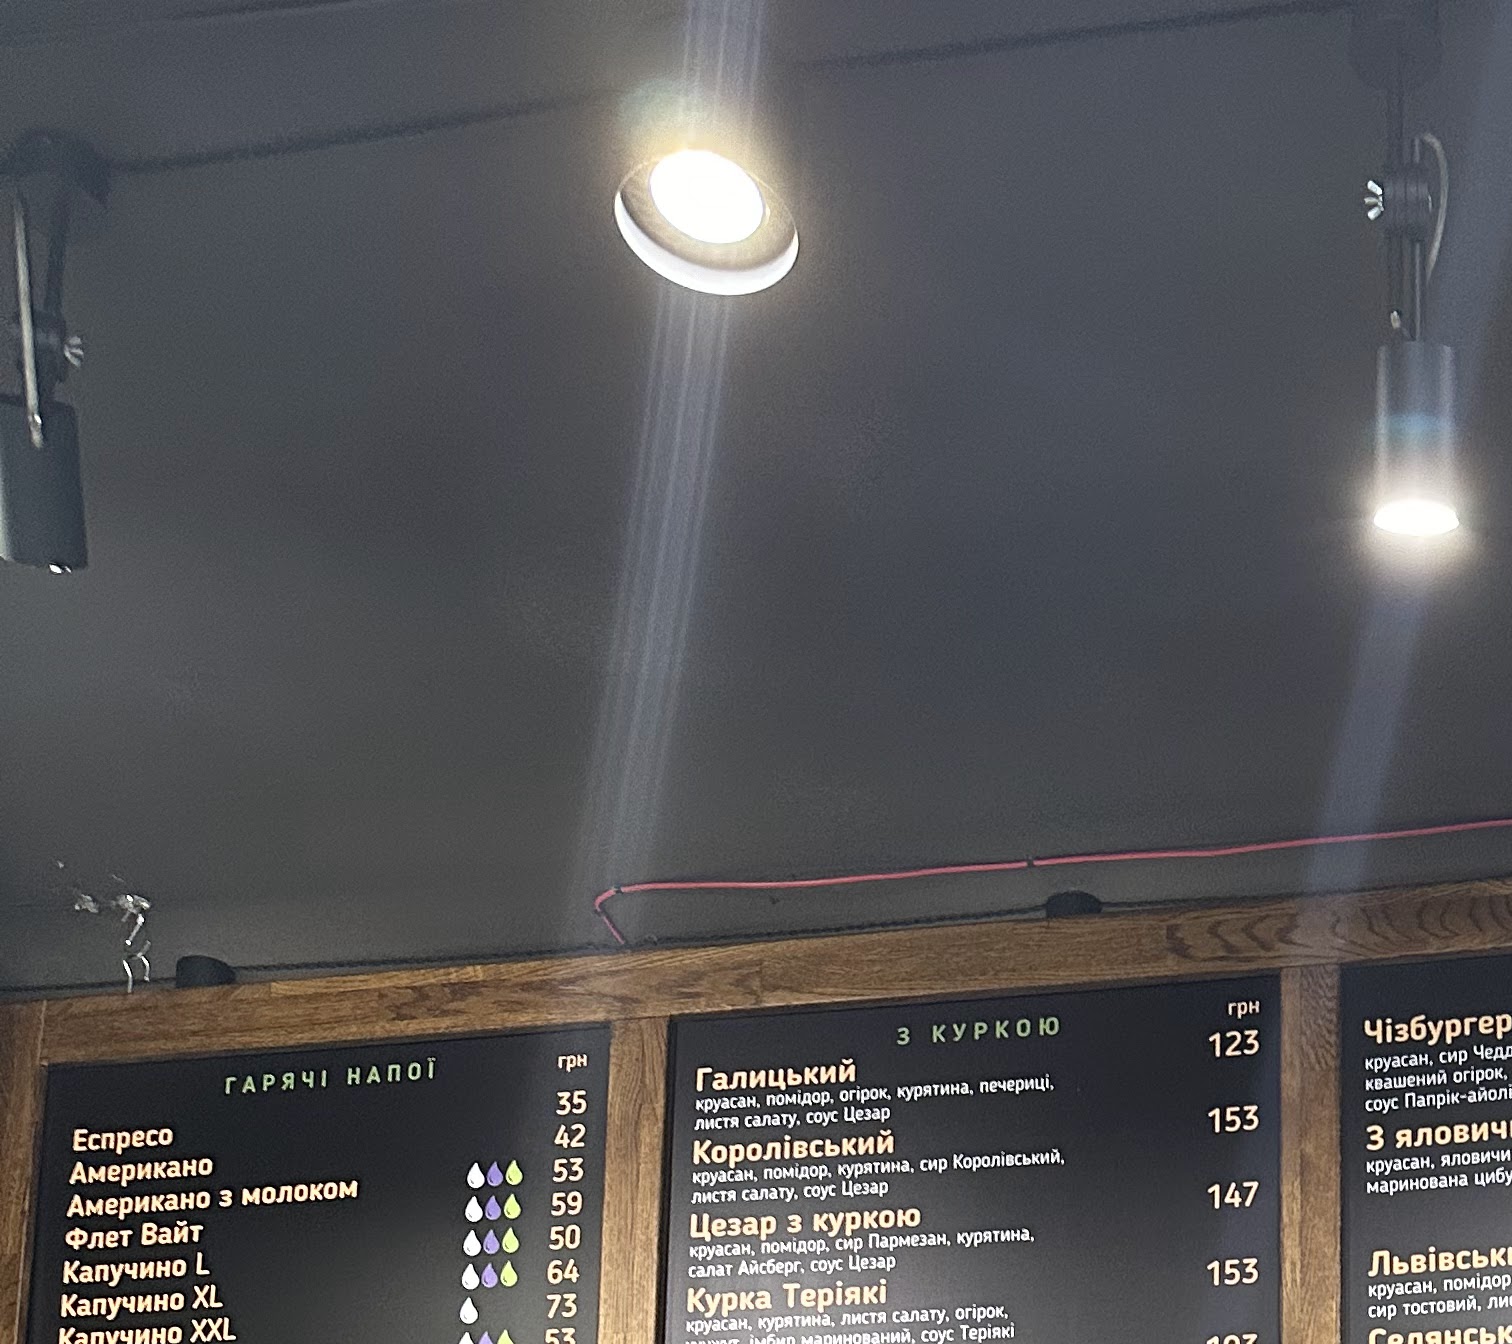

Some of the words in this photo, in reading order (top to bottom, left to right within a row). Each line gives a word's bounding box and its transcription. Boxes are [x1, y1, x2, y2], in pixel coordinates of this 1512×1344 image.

[1229, 1001, 1259, 1019] грн
[896, 1027, 910, 1046] З
[933, 1017, 1059, 1042] КУРКОЮ
[1209, 1030, 1259, 1057] 123
[1365, 1014, 1512, 1045] Чізбургер
[226, 1070, 326, 1094] ГАРЯЧІ
[348, 1058, 435, 1085] НАПОЇ
[558, 1054, 587, 1072] грн
[696, 1058, 856, 1092] Галицький
[556, 1090, 586, 1115] 35
[696, 1096, 760, 1113] круасан,
[767, 1090, 834, 1106] помідор,
[840, 1086, 891, 1104] огірок,
[897, 1083, 973, 1101] курятина,
[980, 1074, 1054, 1094] печериці,
[1208, 1106, 1258, 1132] 153
[73, 1129, 173, 1154] Еспресо
[554, 1124, 585, 1148] 42
[694, 1130, 895, 1165] Королівський
[69, 1159, 212, 1187] Американо
[553, 1157, 583, 1182] 53
[67, 1192, 210, 1220] Американо
[218, 1189, 233, 1208] з
[242, 1181, 358, 1205] молоком
[551, 1191, 583, 1216] 59
[1208, 1181, 1258, 1209] 147
[66, 1227, 133, 1250] Флет
[141, 1221, 203, 1245] Вайт
[690, 1213, 777, 1242] Цезар
[786, 1213, 803, 1234] з
[813, 1208, 922, 1237] куркою
